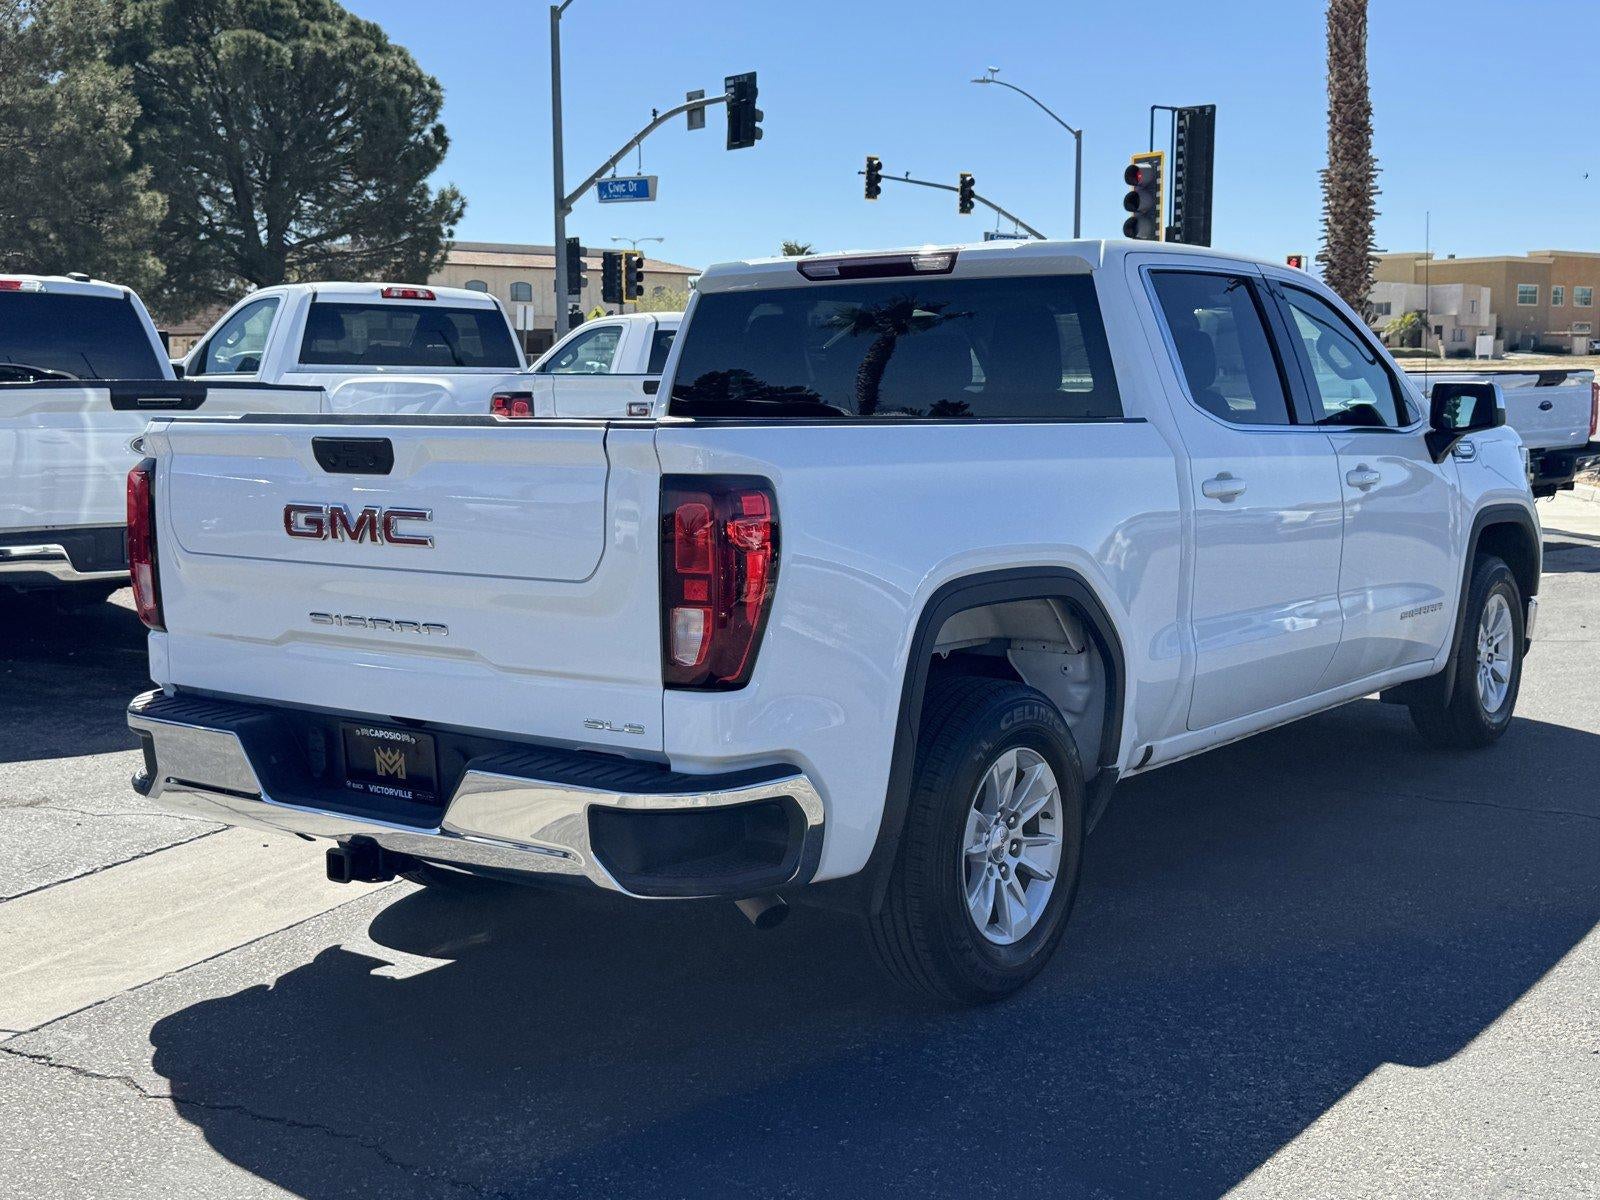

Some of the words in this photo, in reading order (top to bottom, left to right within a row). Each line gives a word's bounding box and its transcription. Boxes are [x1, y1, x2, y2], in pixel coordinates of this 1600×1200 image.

[608, 181, 626, 194] Civic
[628, 180, 637, 192] Dr
[626, 402, 653, 417] G
[283, 501, 434, 548] GMC
[308, 611, 449, 636] SIERRA
[583, 718, 646, 735] SLE
[369, 728, 401, 741] CAPOSIO
[368, 784, 413, 799] VICTORVILLE
